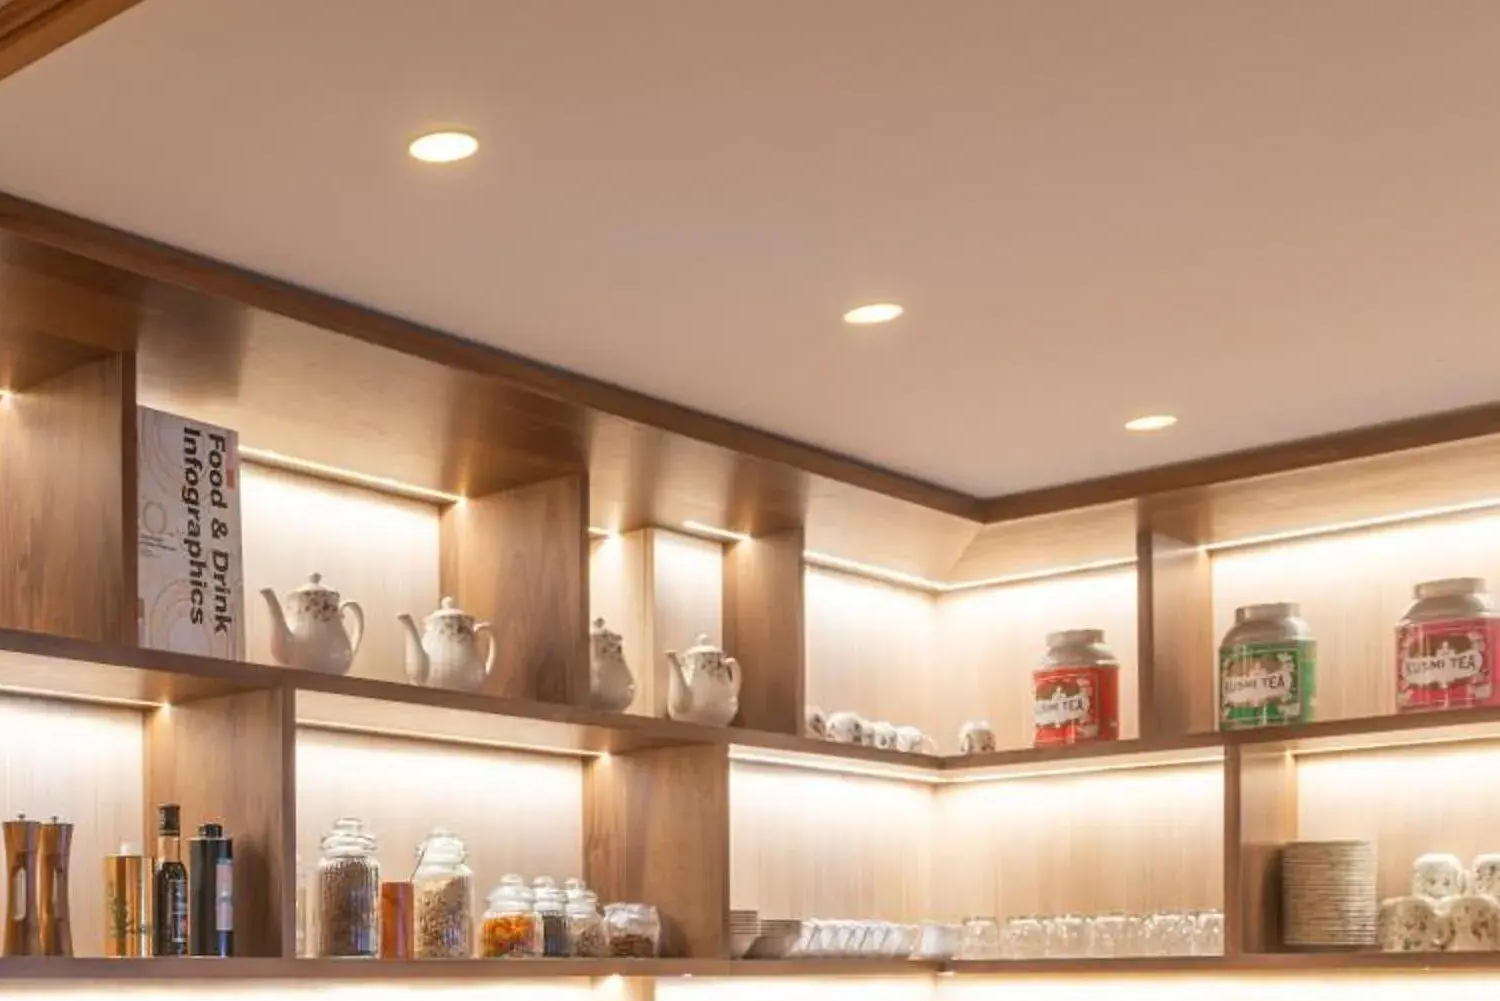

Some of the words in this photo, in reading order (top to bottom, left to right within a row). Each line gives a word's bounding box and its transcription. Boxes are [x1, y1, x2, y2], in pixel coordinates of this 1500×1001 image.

[208, 433, 228, 509] Food
[181, 427, 207, 625] Infographics
[211, 517, 229, 539] &
[212, 550, 233, 633] Drink
[1450, 654, 1476, 670] TEA
[1261, 674, 1285, 690] TEA
[1062, 697, 1084, 711] TEA
